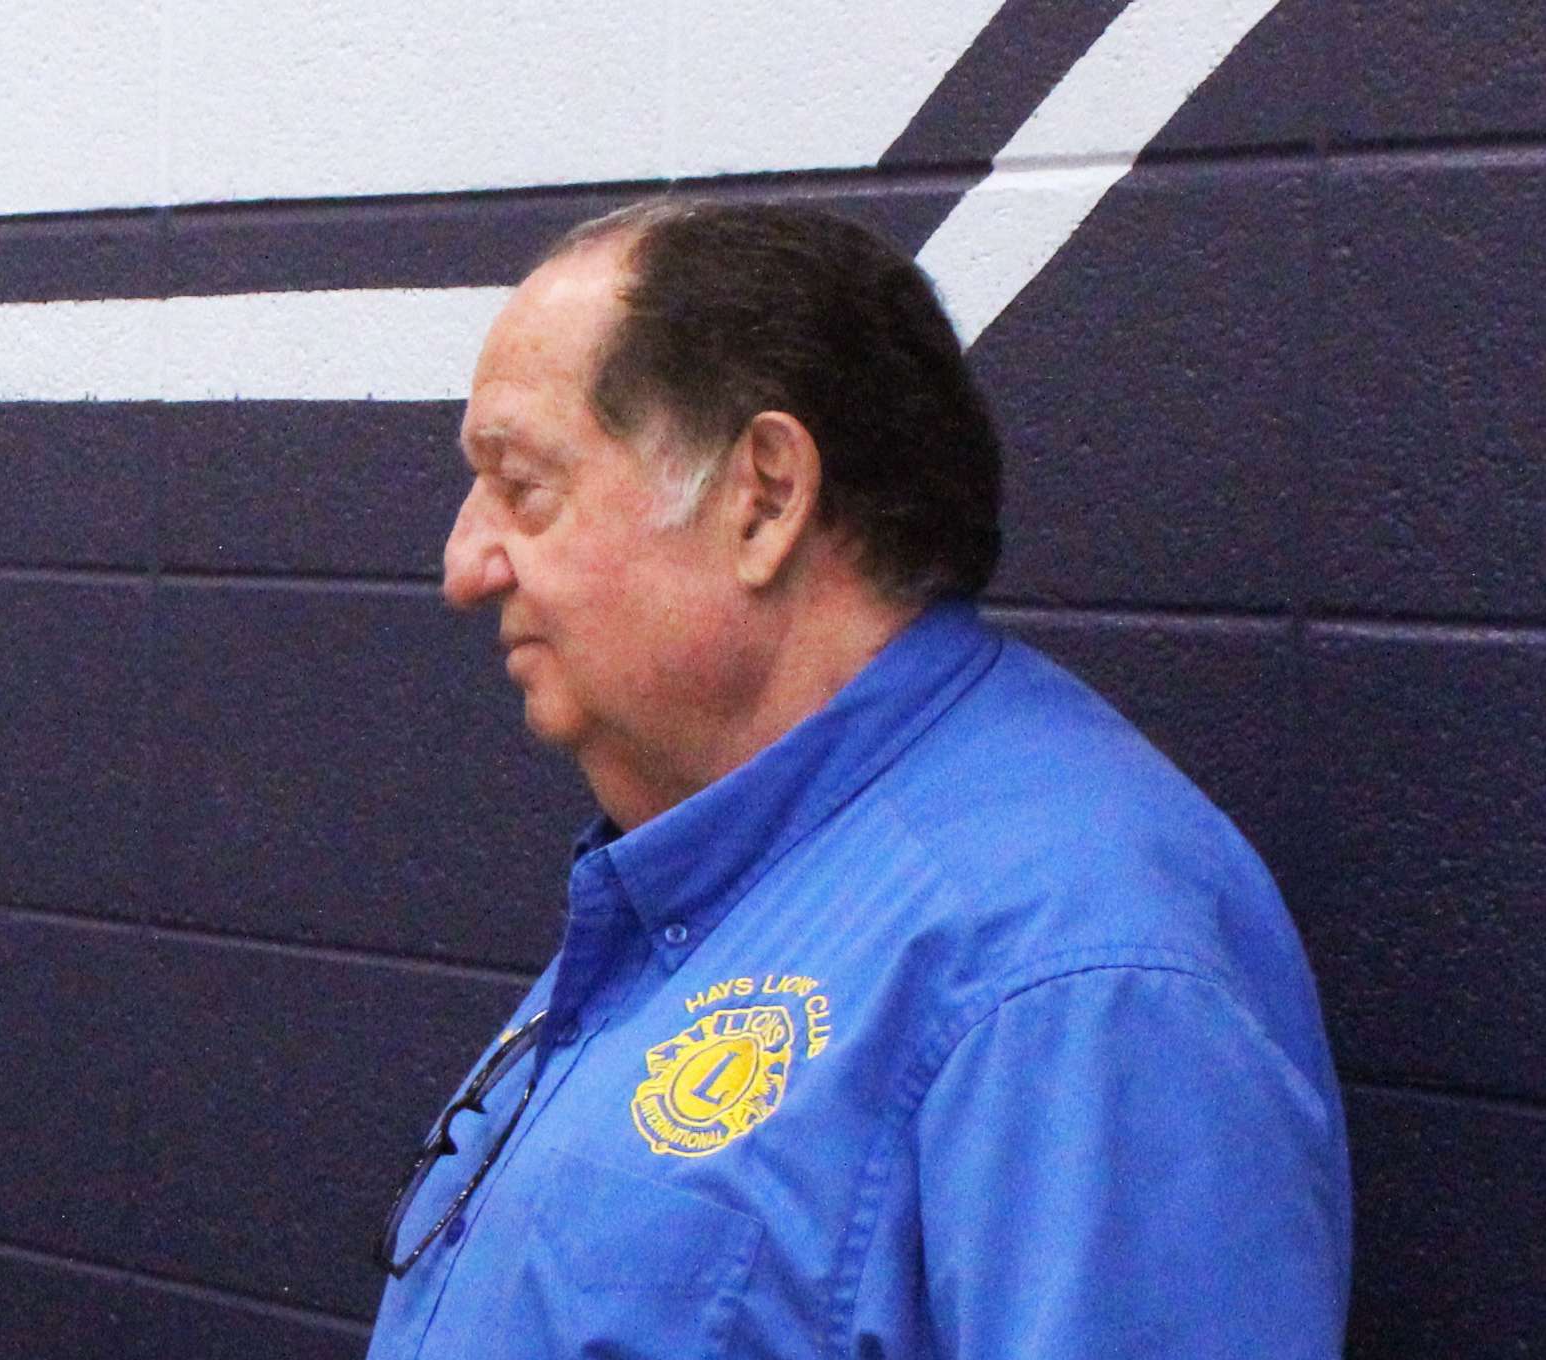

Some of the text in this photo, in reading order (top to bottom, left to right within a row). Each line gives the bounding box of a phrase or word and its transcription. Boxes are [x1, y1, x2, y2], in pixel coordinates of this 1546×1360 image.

[685, 977, 753, 1013] HAYS
[804, 995, 830, 1059] CLUB
[692, 1051, 740, 1104] L
